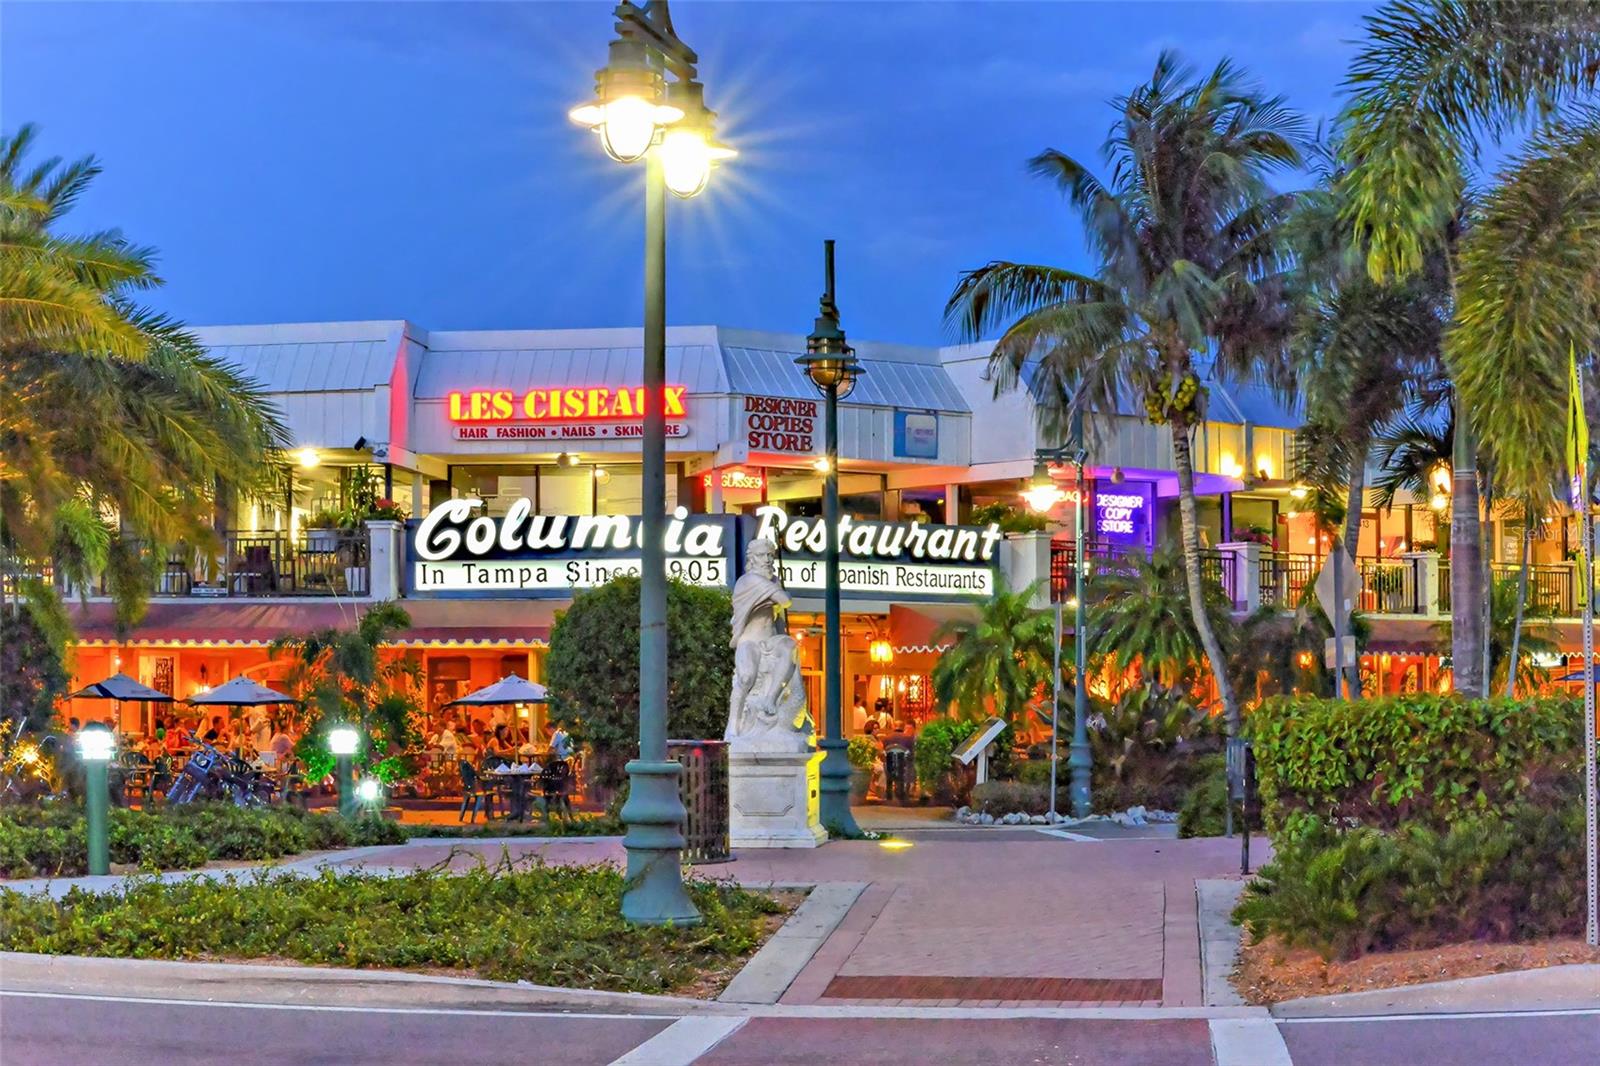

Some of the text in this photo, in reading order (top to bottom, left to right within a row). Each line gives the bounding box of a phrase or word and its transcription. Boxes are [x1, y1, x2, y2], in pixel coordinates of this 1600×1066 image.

[449, 391, 514, 421] LES
[744, 396, 818, 418] DESIGNER
[459, 427, 488, 439] HAIR
[496, 427, 546, 438] FASHION
[562, 426, 596, 437] NAILS
[615, 425, 643, 436] SKIN
[748, 414, 813, 433] COPIES
[748, 431, 813, 451] STORE
[1096, 494, 1144, 508] DESIGNER
[415, 497, 1001, 561] Columia Restaurant
[1101, 519, 1134, 533] STORE
[421, 564, 445, 584] In
[462, 564, 548, 588] Tampa
[800, 561, 817, 583] of
[839, 564, 889, 586] panish
[896, 566, 986, 590] Restaurants
